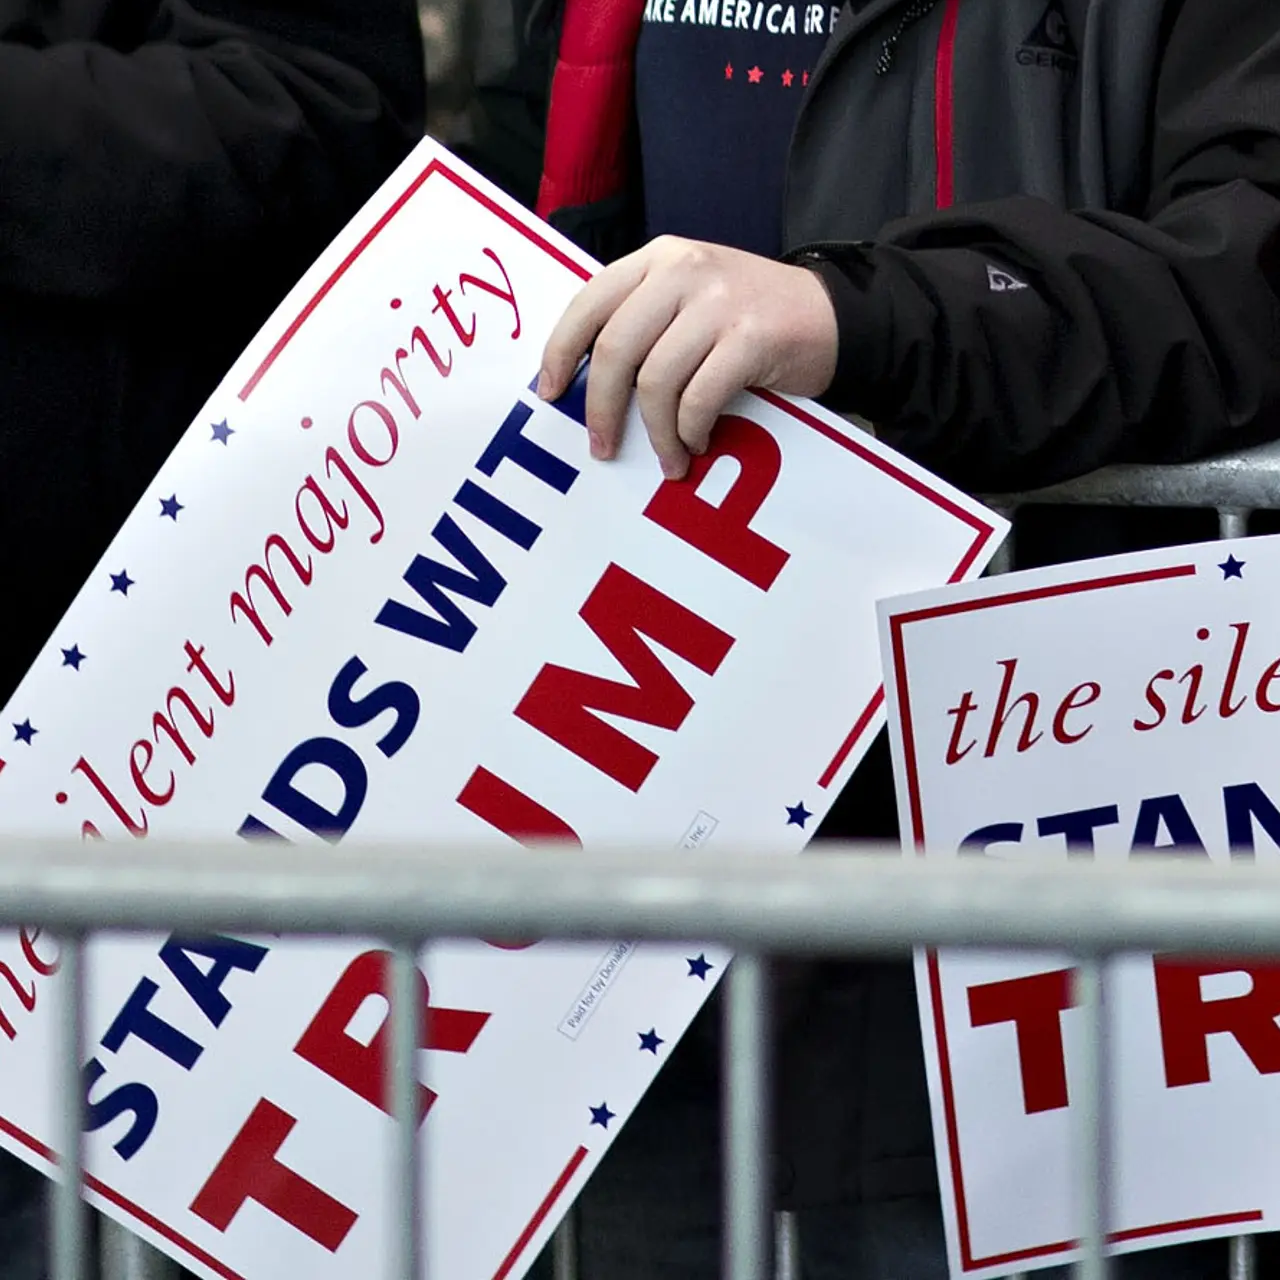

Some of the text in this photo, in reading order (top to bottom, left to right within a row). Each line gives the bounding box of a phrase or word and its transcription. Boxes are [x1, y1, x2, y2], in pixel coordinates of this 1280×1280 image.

[230, 246, 521, 645] majority
[81, 655, 421, 1161] STADS
[945, 658, 1101, 766] the
